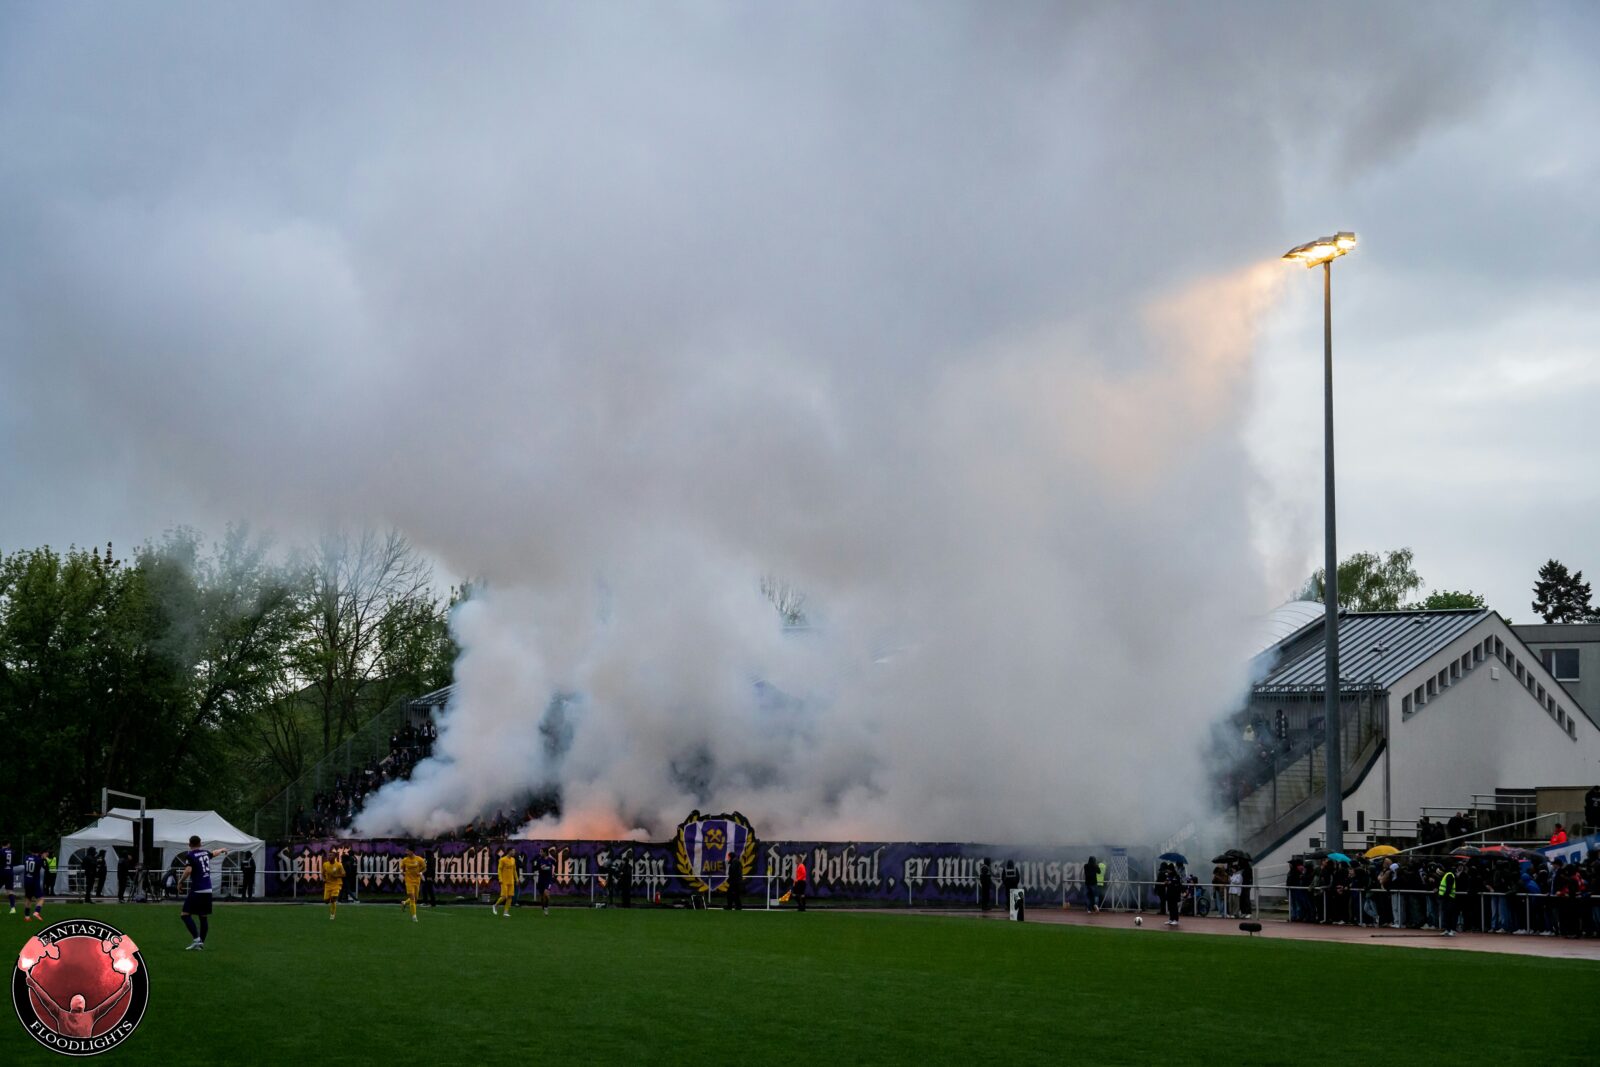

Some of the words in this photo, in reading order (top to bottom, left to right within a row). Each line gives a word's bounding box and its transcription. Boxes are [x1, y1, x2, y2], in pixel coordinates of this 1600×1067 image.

[6, 853, 12, 865] 9
[198, 855, 210, 873] 13
[424, 846, 492, 884] trahlt
[26, 860, 35, 873] 10
[702, 860, 724, 872] AUE
